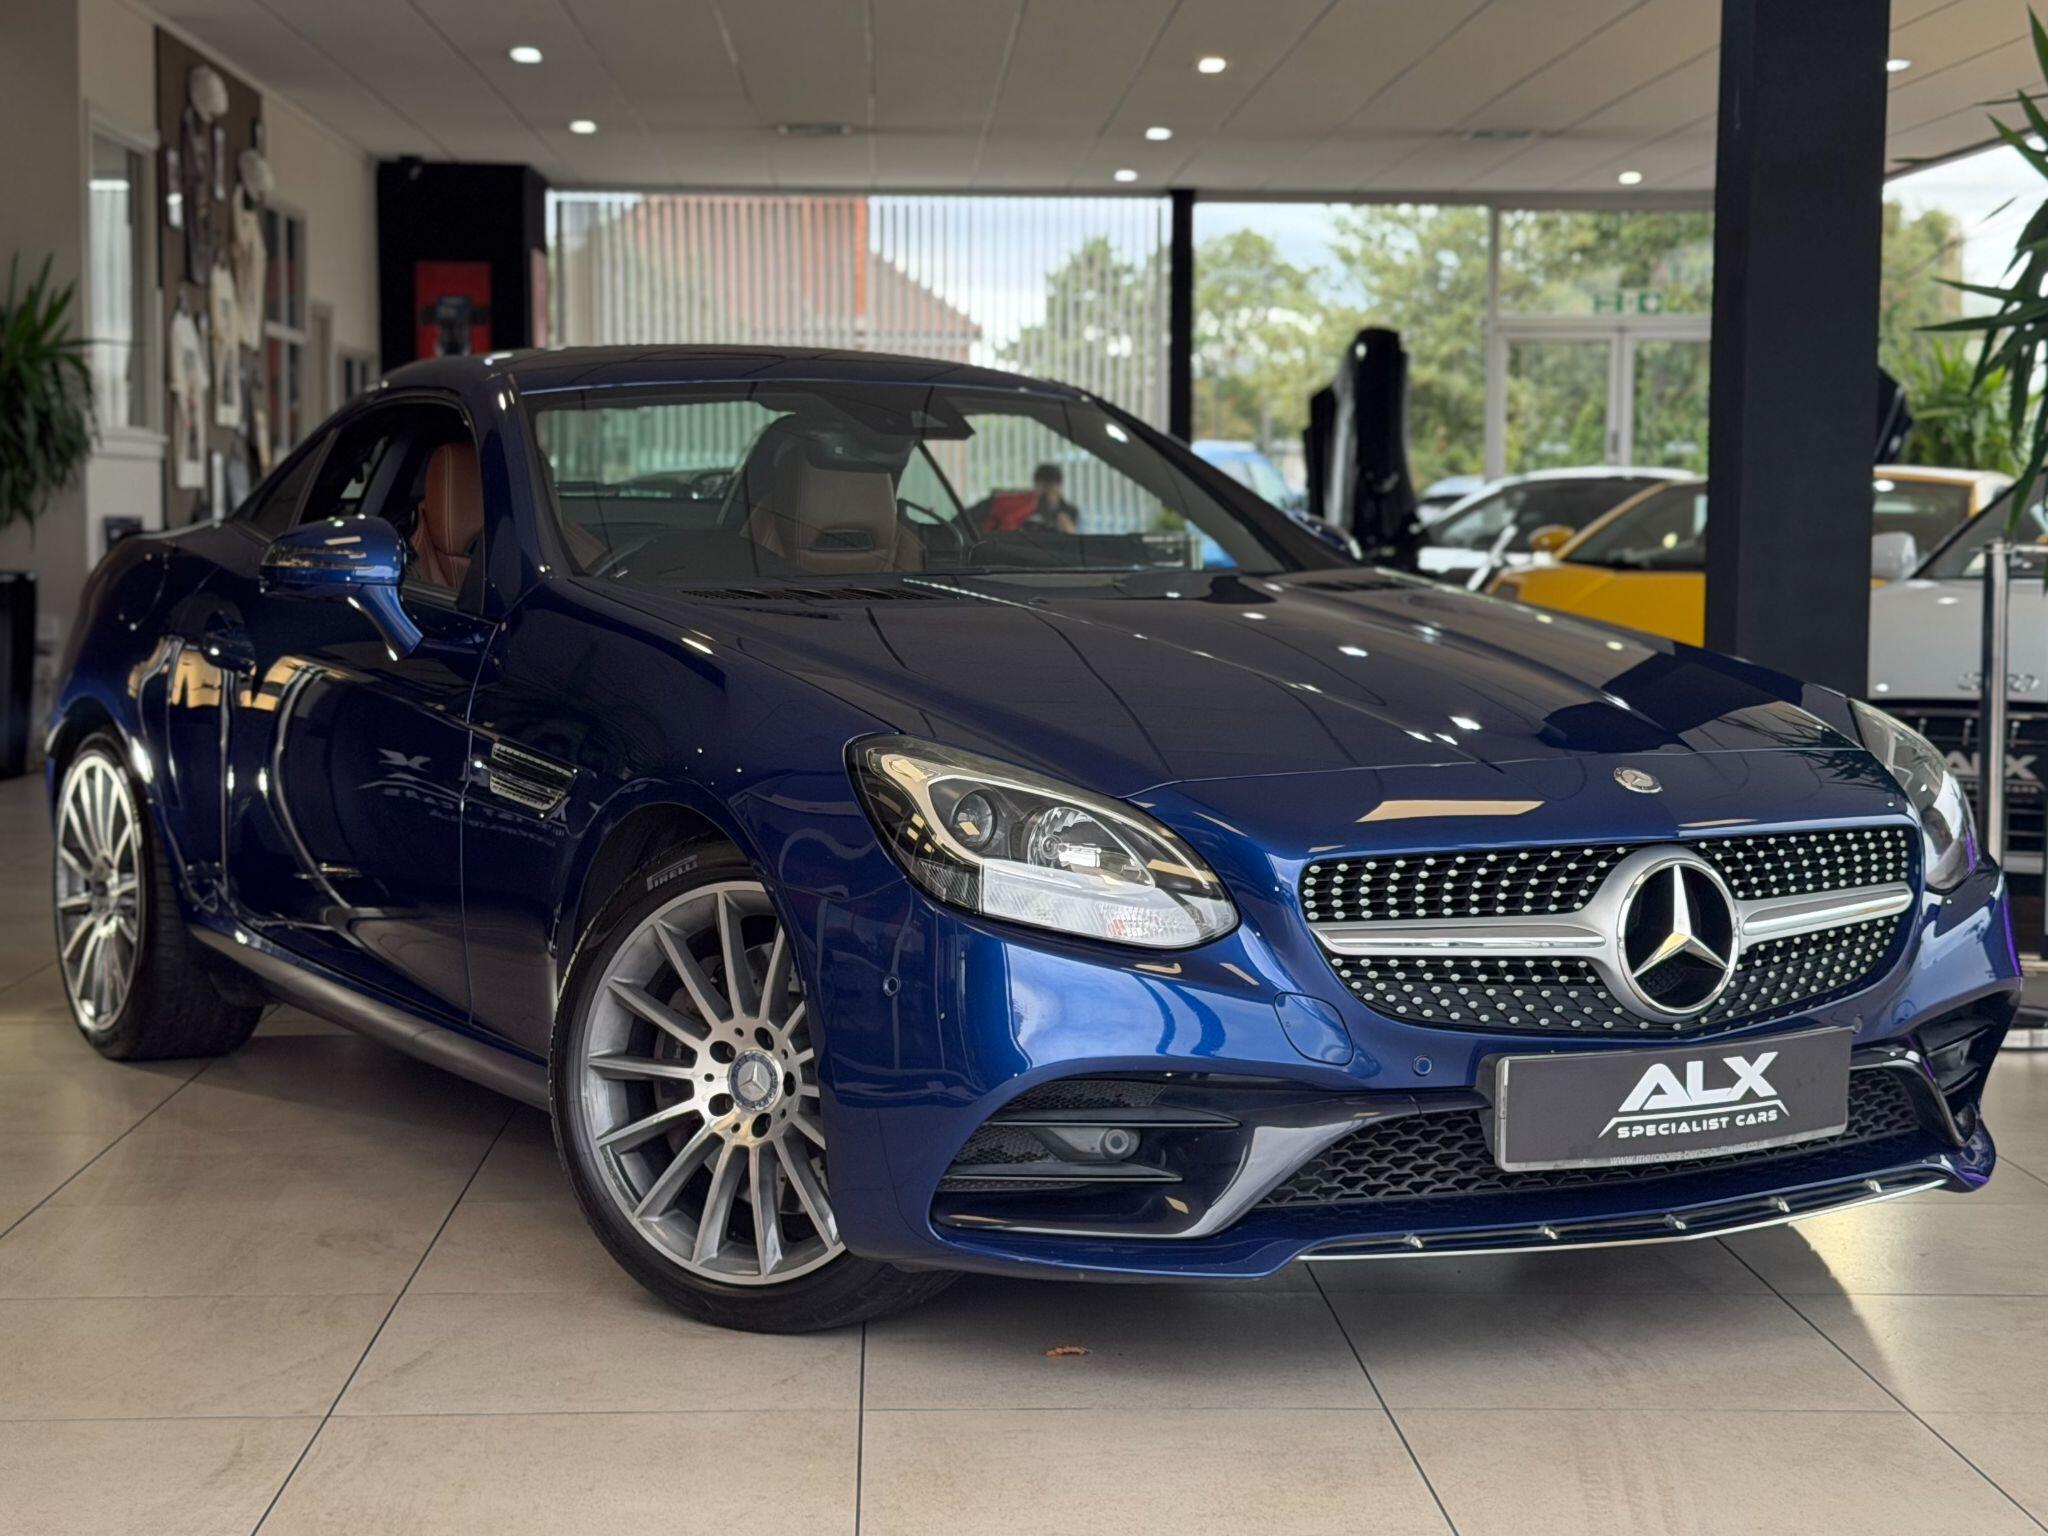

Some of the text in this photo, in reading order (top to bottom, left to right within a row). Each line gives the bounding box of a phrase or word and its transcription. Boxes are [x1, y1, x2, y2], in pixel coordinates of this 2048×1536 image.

[646, 854, 699, 891] PIRELLI
[1618, 1051, 1779, 1113] ALX
[1617, 1109, 1778, 1139] SPECIALIST CARS
